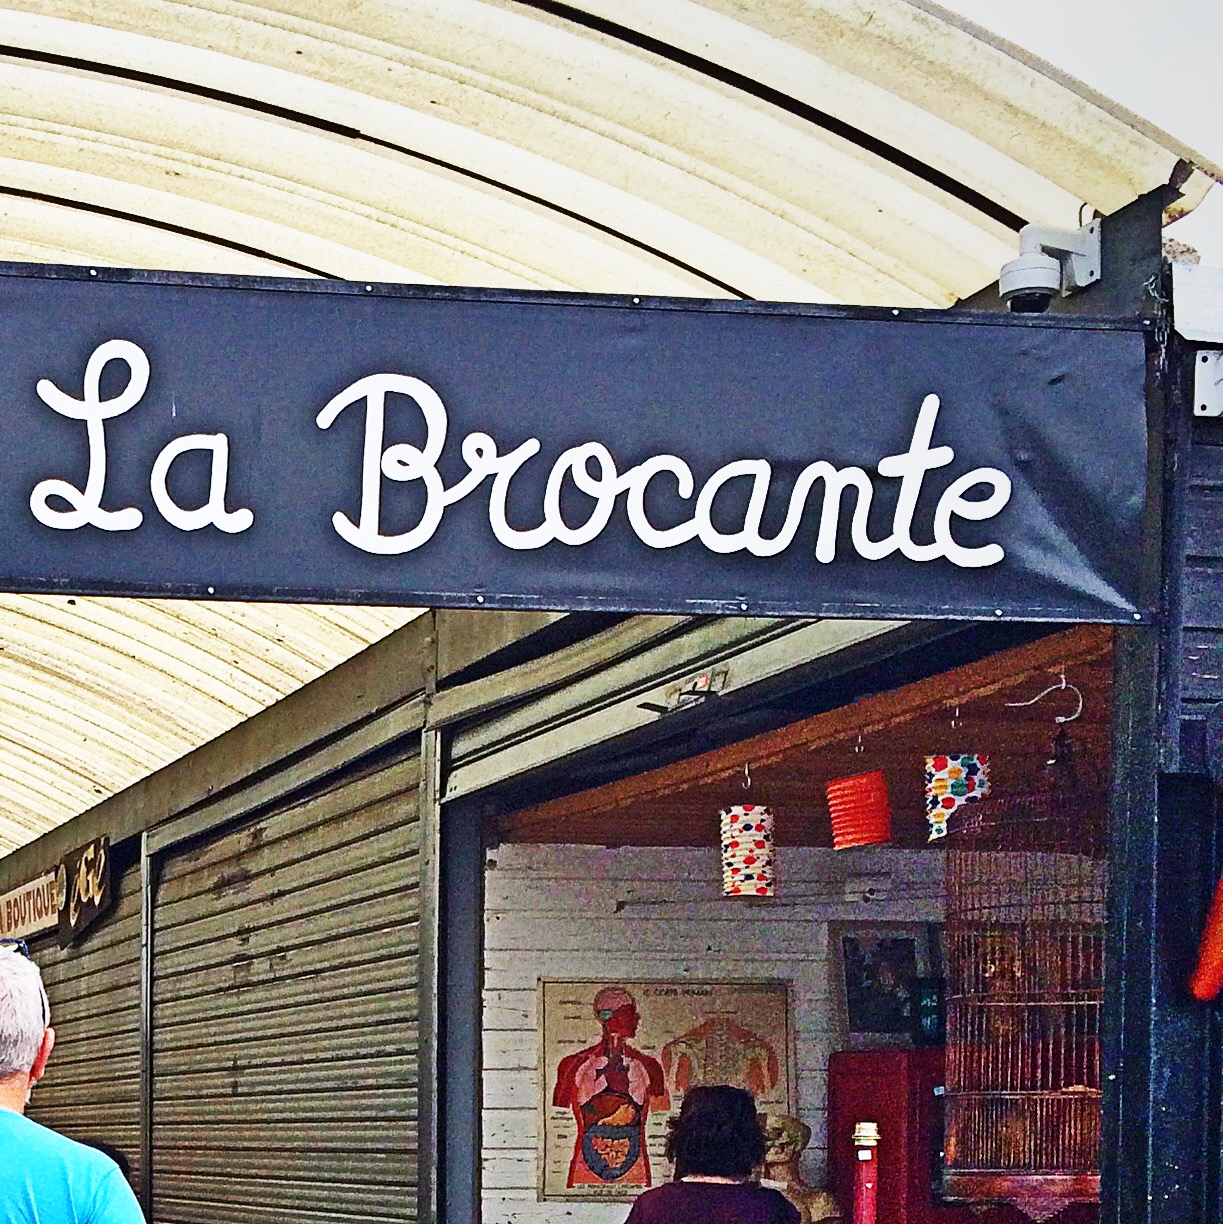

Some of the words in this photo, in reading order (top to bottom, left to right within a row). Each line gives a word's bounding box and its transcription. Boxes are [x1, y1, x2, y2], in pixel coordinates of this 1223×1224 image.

[30, 340, 253, 533] La
[317, 374, 1011, 567] Brocante
[6, 880, 58, 932] BOUTIQUE
